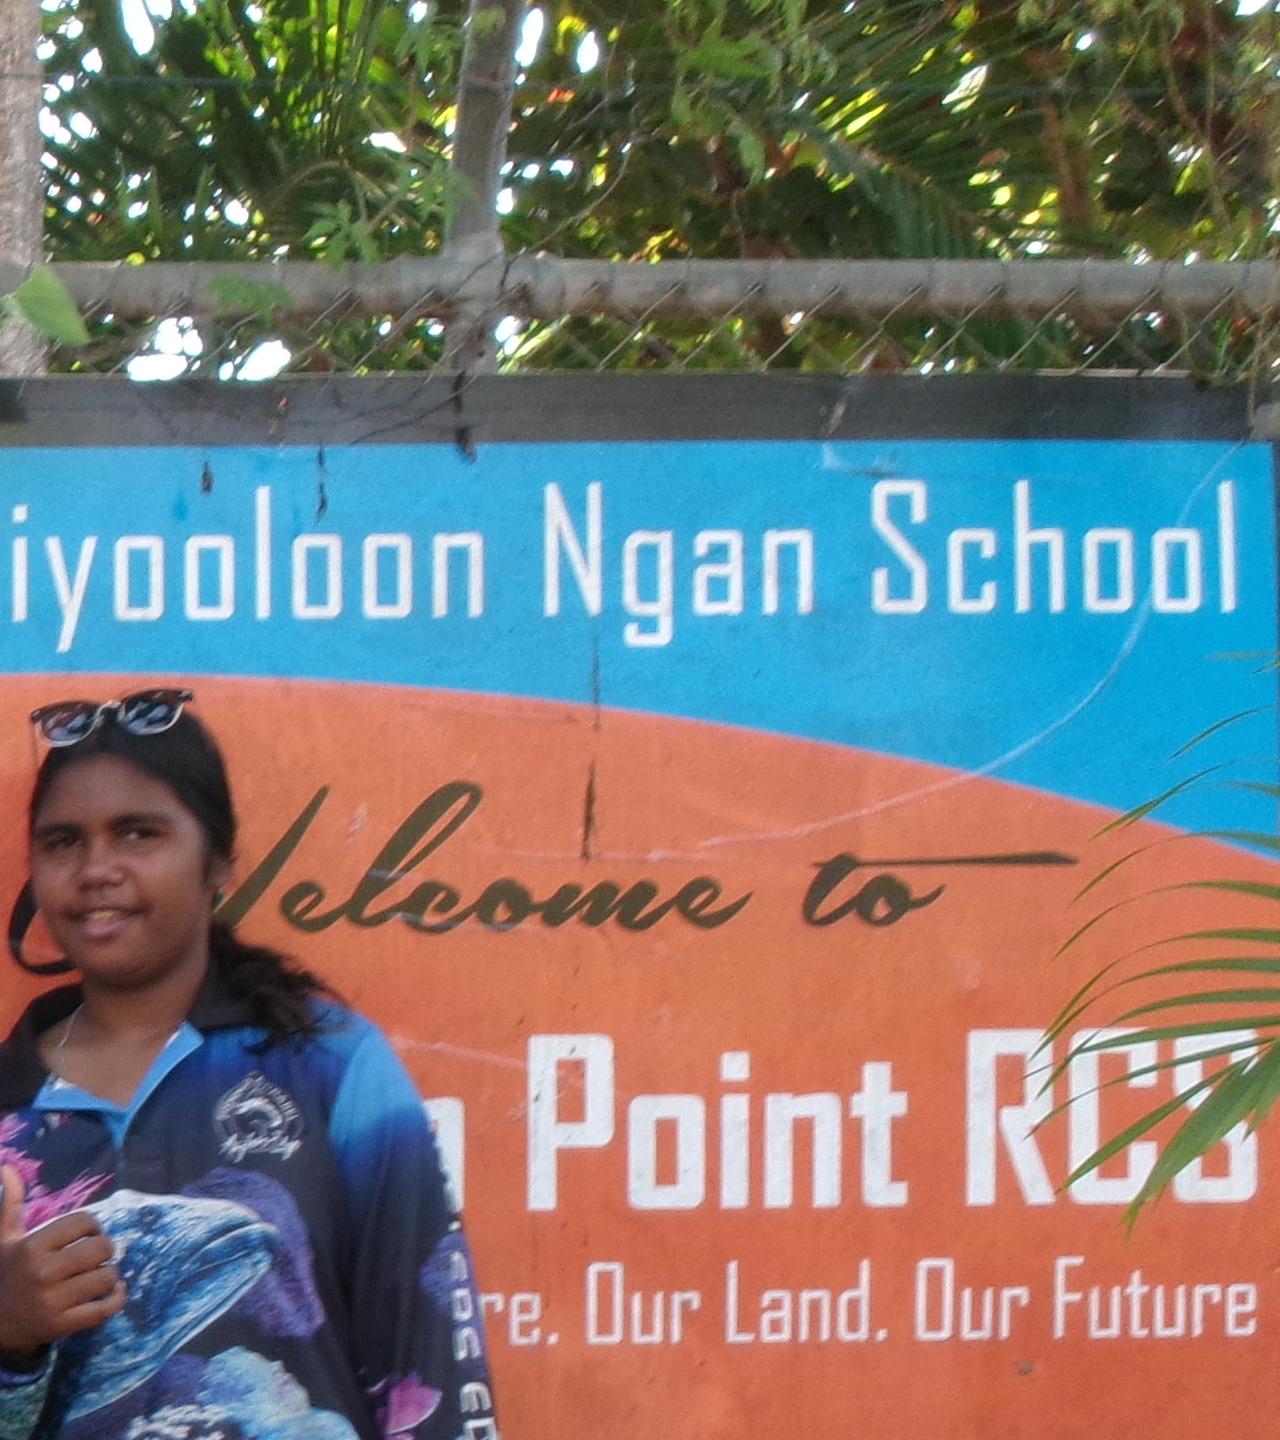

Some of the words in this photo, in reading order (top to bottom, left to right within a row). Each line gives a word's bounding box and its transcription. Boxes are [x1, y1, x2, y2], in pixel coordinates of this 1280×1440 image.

[543, 483, 813, 647] Ngan
[871, 480, 1236, 614] School
[802, 852, 1078, 929] to
[527, 1033, 907, 1212] Point
[966, 1027, 1258, 1206] RCS
[584, 1261, 701, 1346] Our
[725, 1258, 889, 1345] Land.
[915, 1256, 1030, 1343] Our
[1053, 1255, 1259, 1339] Future
